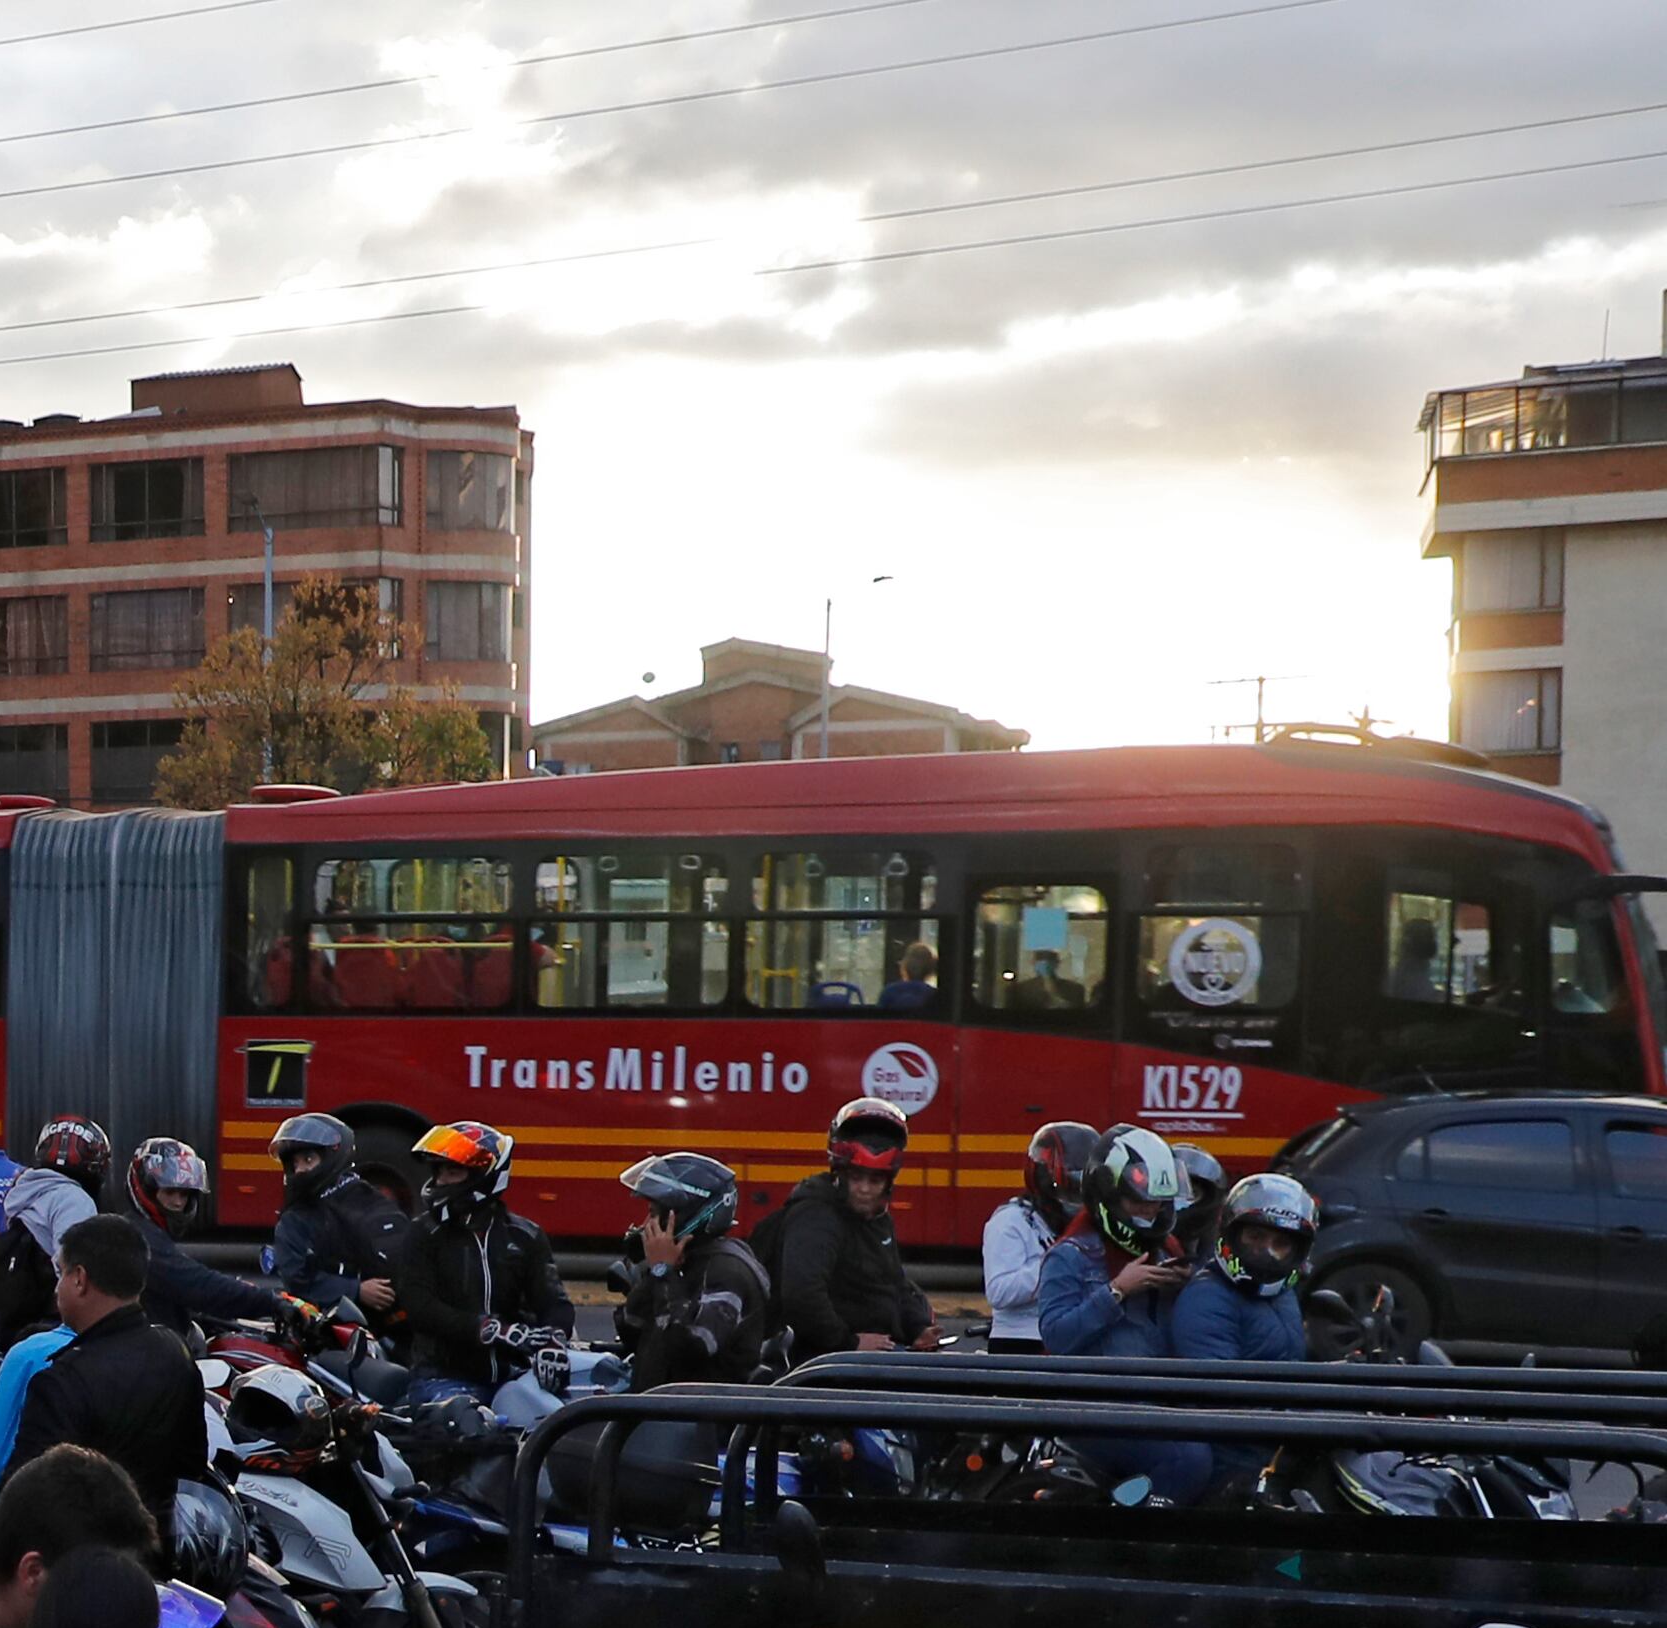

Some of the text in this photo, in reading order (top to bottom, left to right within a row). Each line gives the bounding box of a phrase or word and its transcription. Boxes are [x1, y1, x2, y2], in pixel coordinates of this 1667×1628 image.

[466, 1046, 808, 1094] TransMilenio
[873, 1067, 901, 1083] Gas
[1143, 1065, 1243, 1110] K1529
